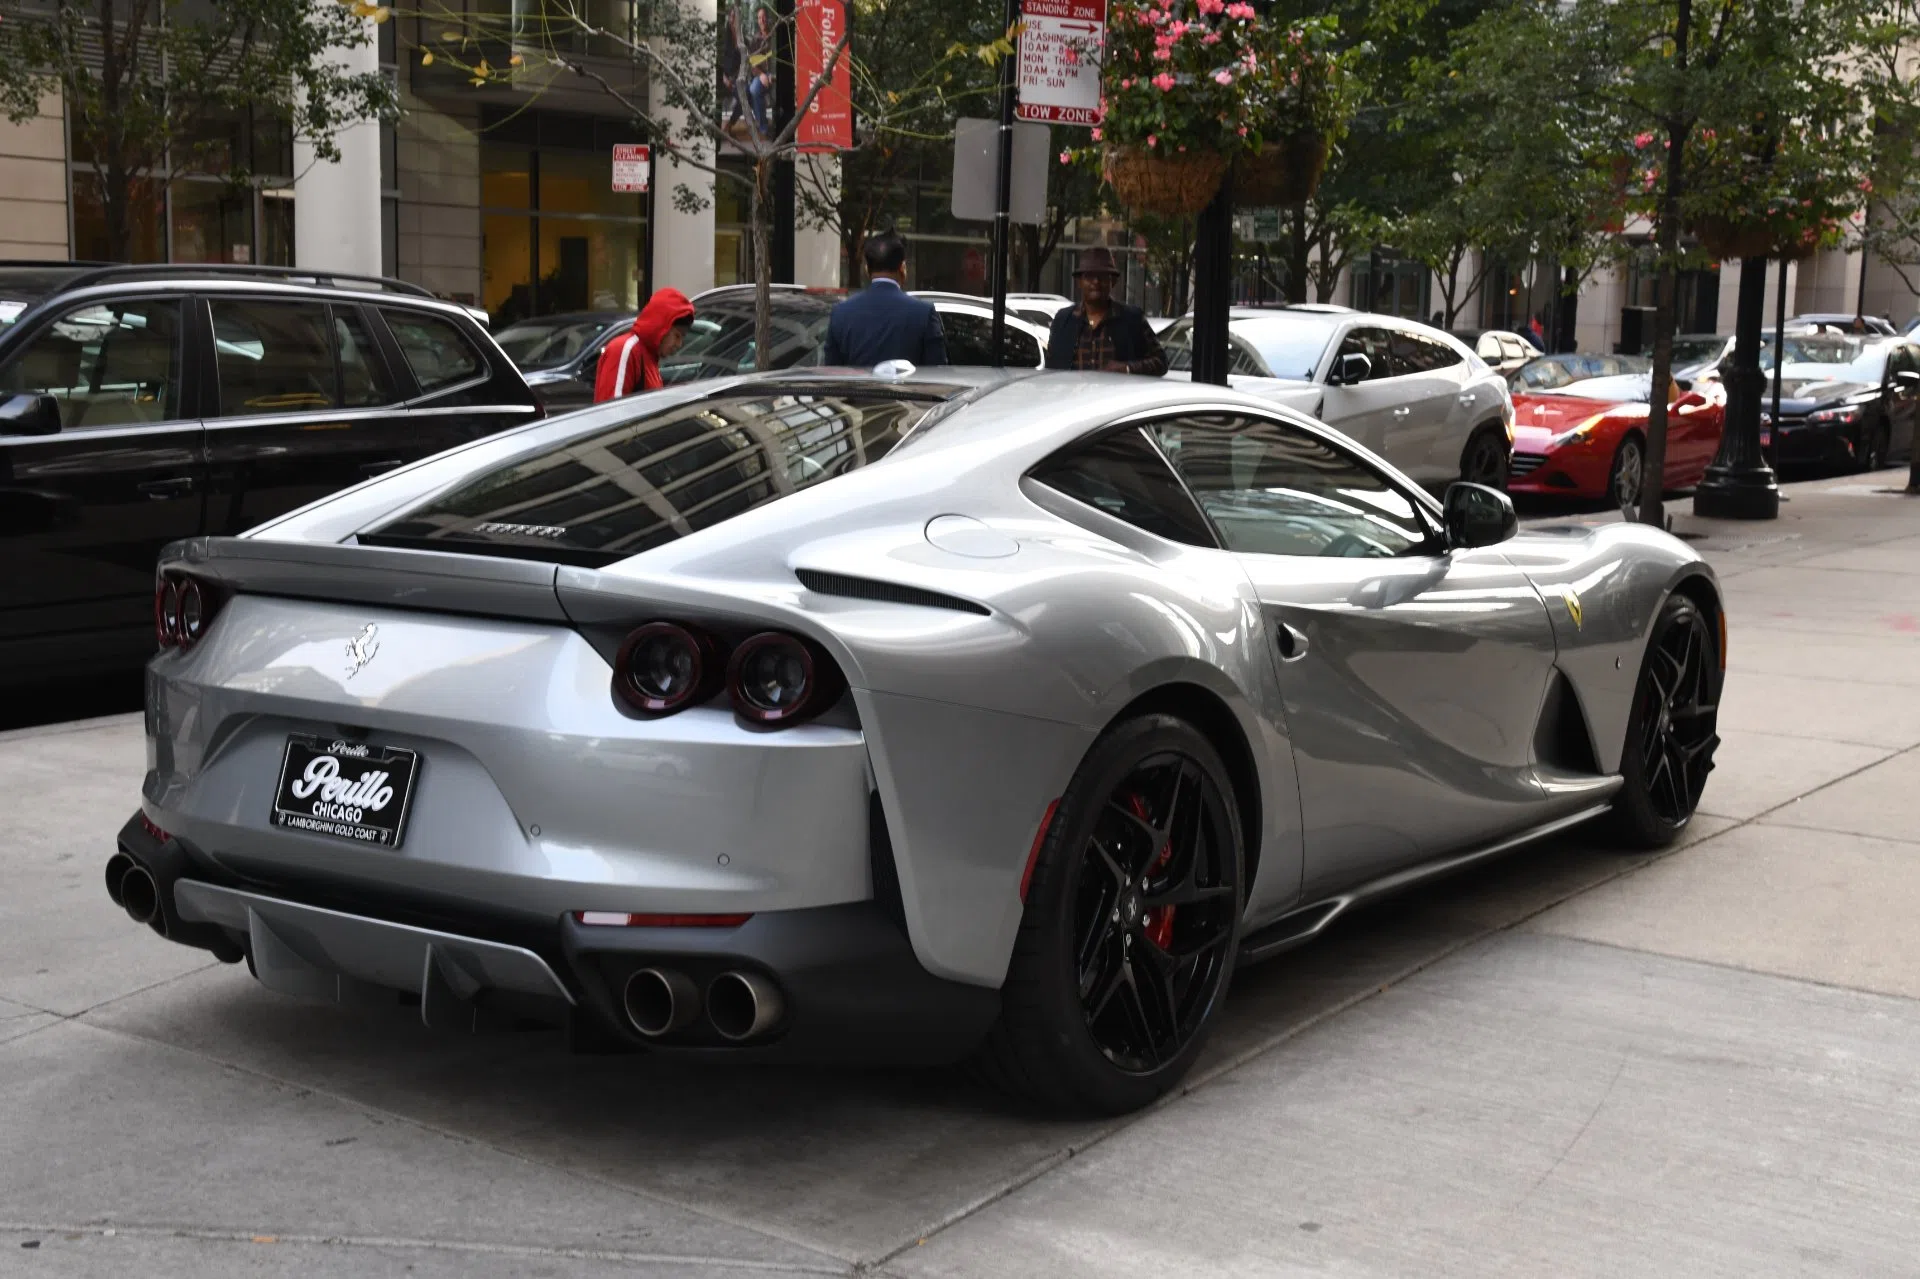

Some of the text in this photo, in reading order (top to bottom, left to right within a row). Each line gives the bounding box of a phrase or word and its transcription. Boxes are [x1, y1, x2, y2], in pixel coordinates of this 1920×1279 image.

[1026, 3, 1096, 19] STANDING ZONE
[1024, 19, 1043, 30] USE
[1036, 43, 1049, 53] AM
[1023, 53, 1044, 63] MON
[1034, 66, 1048, 76] AM
[1057, 69, 1063, 77] 6
[1065, 68, 1078, 78] PM
[1023, 75, 1038, 86] FRI
[1046, 77, 1065, 88] SUN
[1023, 105, 1092, 121] TOW ZONE
[615, 153, 645, 161] CLEANING
[292, 755, 394, 812] Perillo
[312, 801, 363, 823] CHICAGO
[287, 816, 377, 840] LAMBORGHINI GOLD COAST
